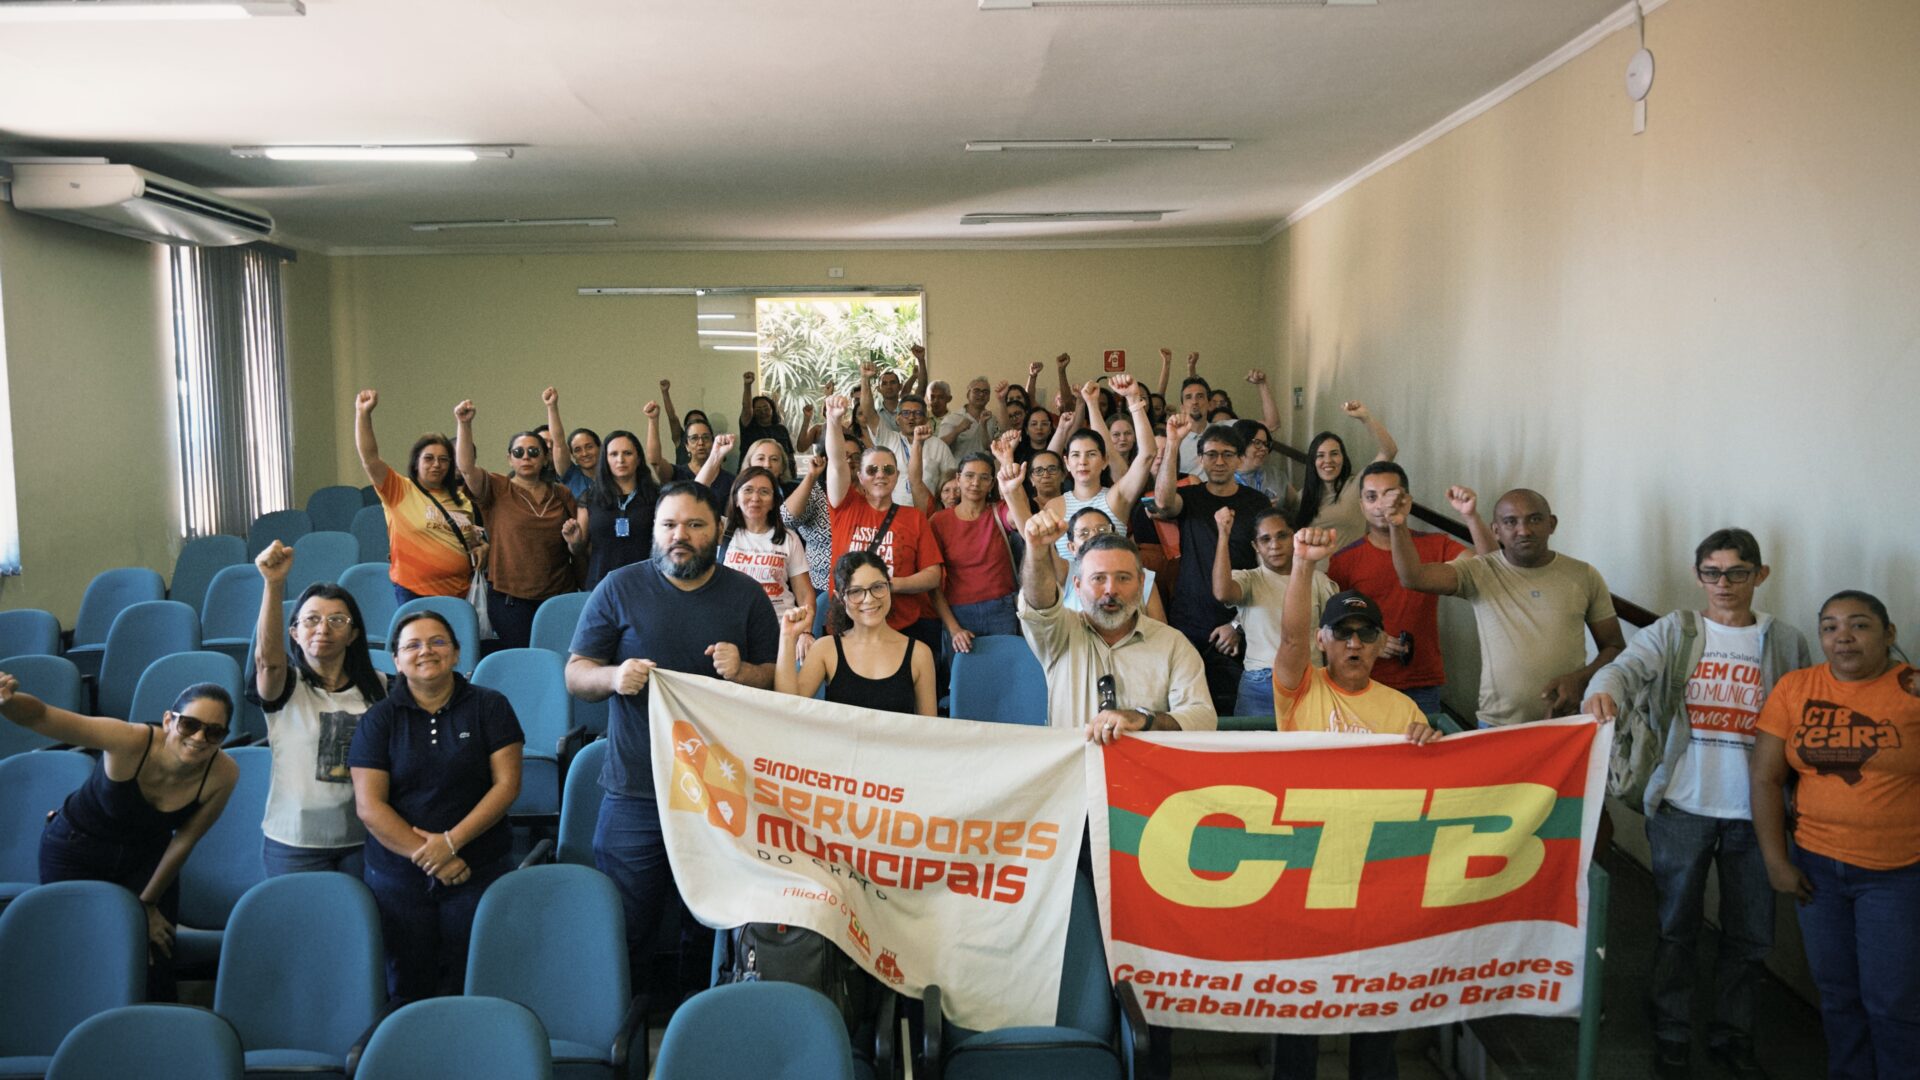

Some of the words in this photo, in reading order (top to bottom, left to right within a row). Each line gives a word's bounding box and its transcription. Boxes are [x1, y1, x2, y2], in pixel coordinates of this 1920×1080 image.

[1691, 661, 1729, 680] UEM
[1804, 706, 1852, 726] CTB
[862, 781, 904, 803] DOS
[753, 777, 1061, 861] SERVIDORES
[757, 850, 793, 864] DO
[757, 813, 1029, 904] MUNICIPAIS
[1138, 782, 1558, 909] CTB
[783, 887, 838, 906] Filiado
[1114, 964, 1243, 991] Central
[1253, 974, 1318, 994] dos
[1332, 958, 1574, 993] Trabalhadores
[1143, 990, 1399, 1019] Trabalhadoras
[1409, 992, 1449, 1013] do
[1459, 980, 1562, 1004] Brasil
